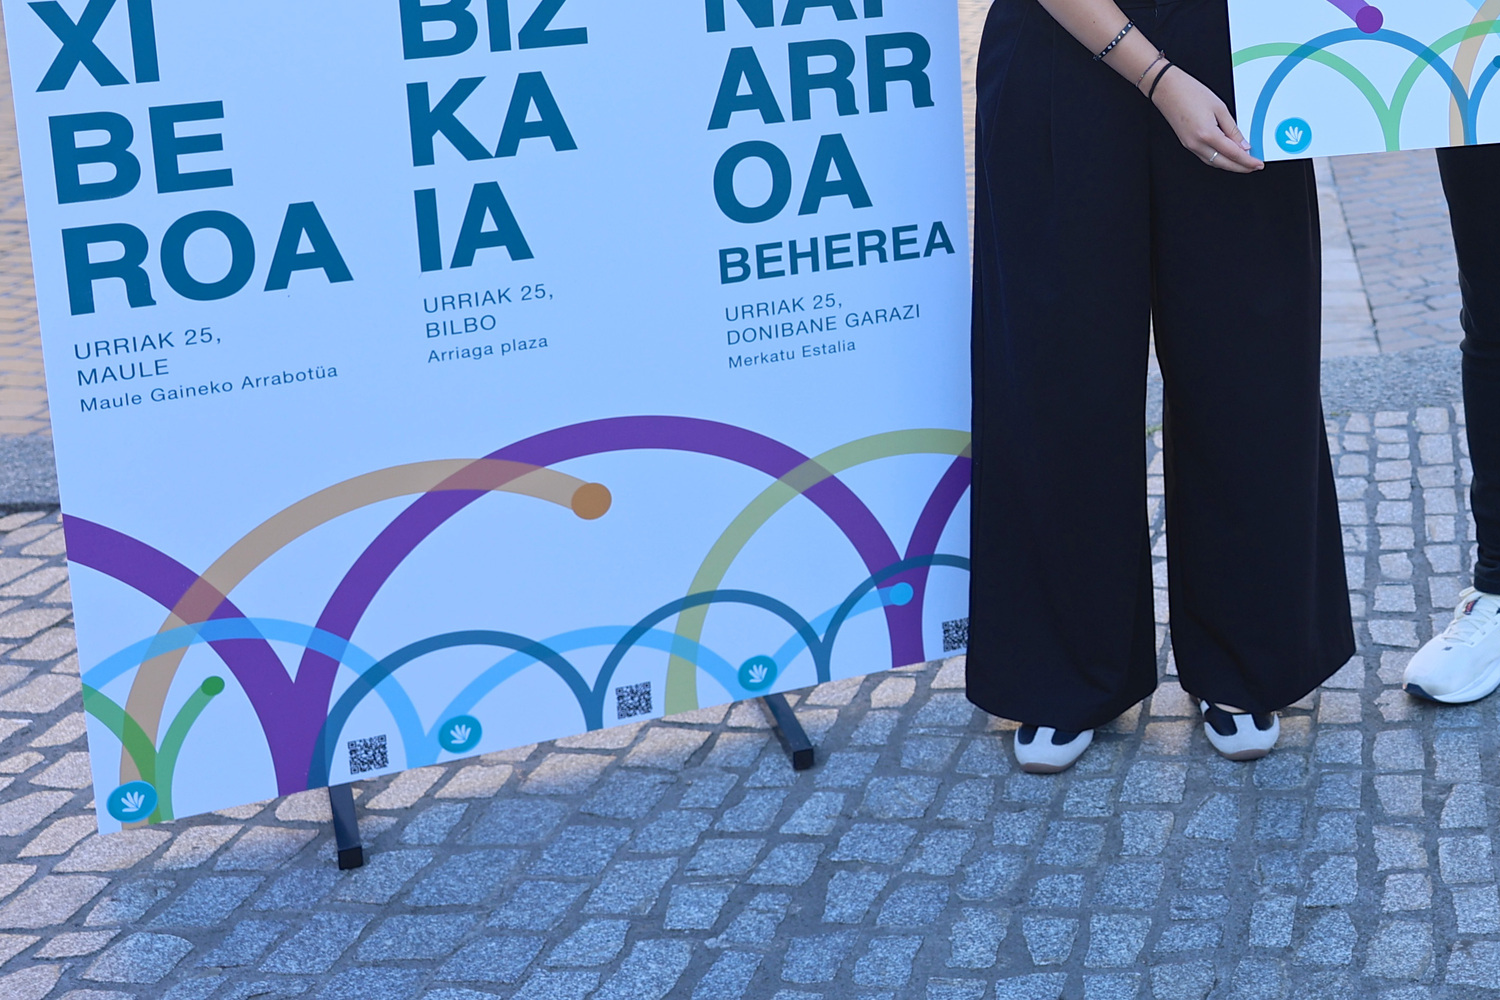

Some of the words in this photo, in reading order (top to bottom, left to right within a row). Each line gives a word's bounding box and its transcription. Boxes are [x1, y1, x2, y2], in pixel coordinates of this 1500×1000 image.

[707, 32, 935, 131] ARR
[406, 71, 578, 167] KA
[48, 100, 234, 205] BE
[713, 133, 873, 224] OA
[414, 181, 534, 273] IA
[61, 201, 354, 316] ROA
[718, 221, 956, 285] BEHEREA
[423, 286, 512, 314] URRIAK
[520, 283, 554, 301] 25,
[725, 296, 805, 323] URRIAK
[812, 292, 843, 310] 25,
[74, 331, 175, 360] URRIAK
[184, 327, 222, 346] 25,
[426, 314, 497, 339] BILBO
[726, 315, 838, 346] DONIBANE
[845, 303, 921, 329] GARAZI
[77, 358, 170, 387] MAULE
[427, 345, 494, 364] Arriaga
[500, 337, 549, 357] plaza
[728, 350, 795, 369] Merkatu
[802, 340, 856, 358] Estalia
[79, 392, 143, 413] Maule
[150, 380, 234, 403] Gaineko
[241, 365, 339, 390] Arrabotüa
